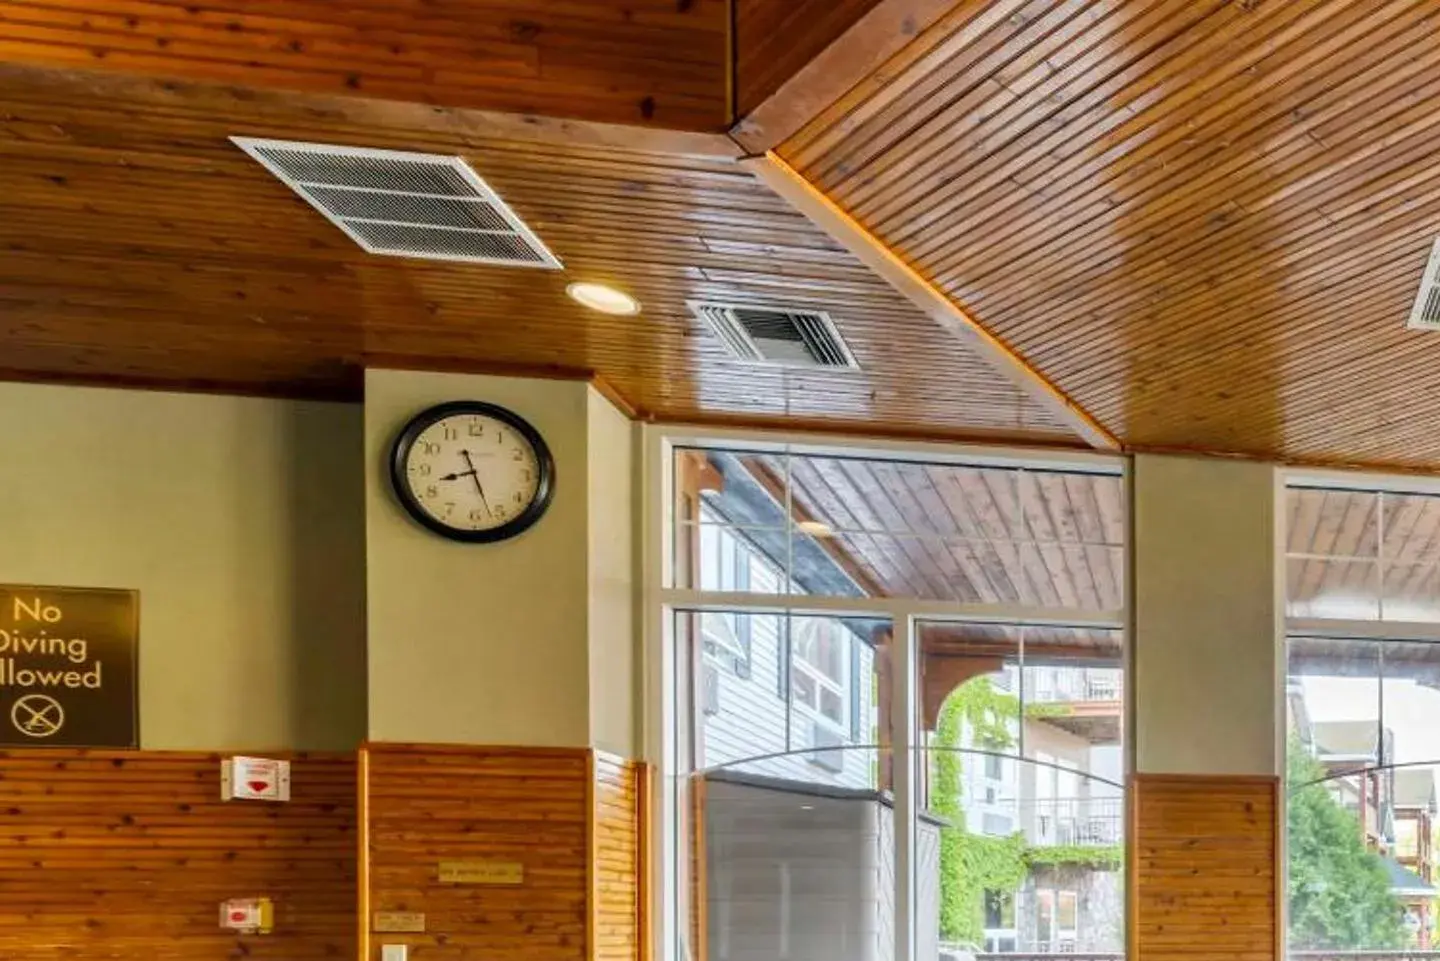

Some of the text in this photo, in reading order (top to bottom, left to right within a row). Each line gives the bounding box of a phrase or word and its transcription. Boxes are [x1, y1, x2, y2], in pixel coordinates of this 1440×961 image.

[444, 428, 458, 441] 11
[469, 423, 483, 437] 12
[424, 442, 441, 456] 10
[512, 448, 524, 462] 2
[419, 463, 431, 476] 9
[427, 485, 438, 498] 8
[444, 502, 456, 515] 7
[469, 509, 482, 522] 6
[14, 596, 62, 623] No
[0, 628, 87, 663] Diving
[0, 657, 102, 689] llowed
